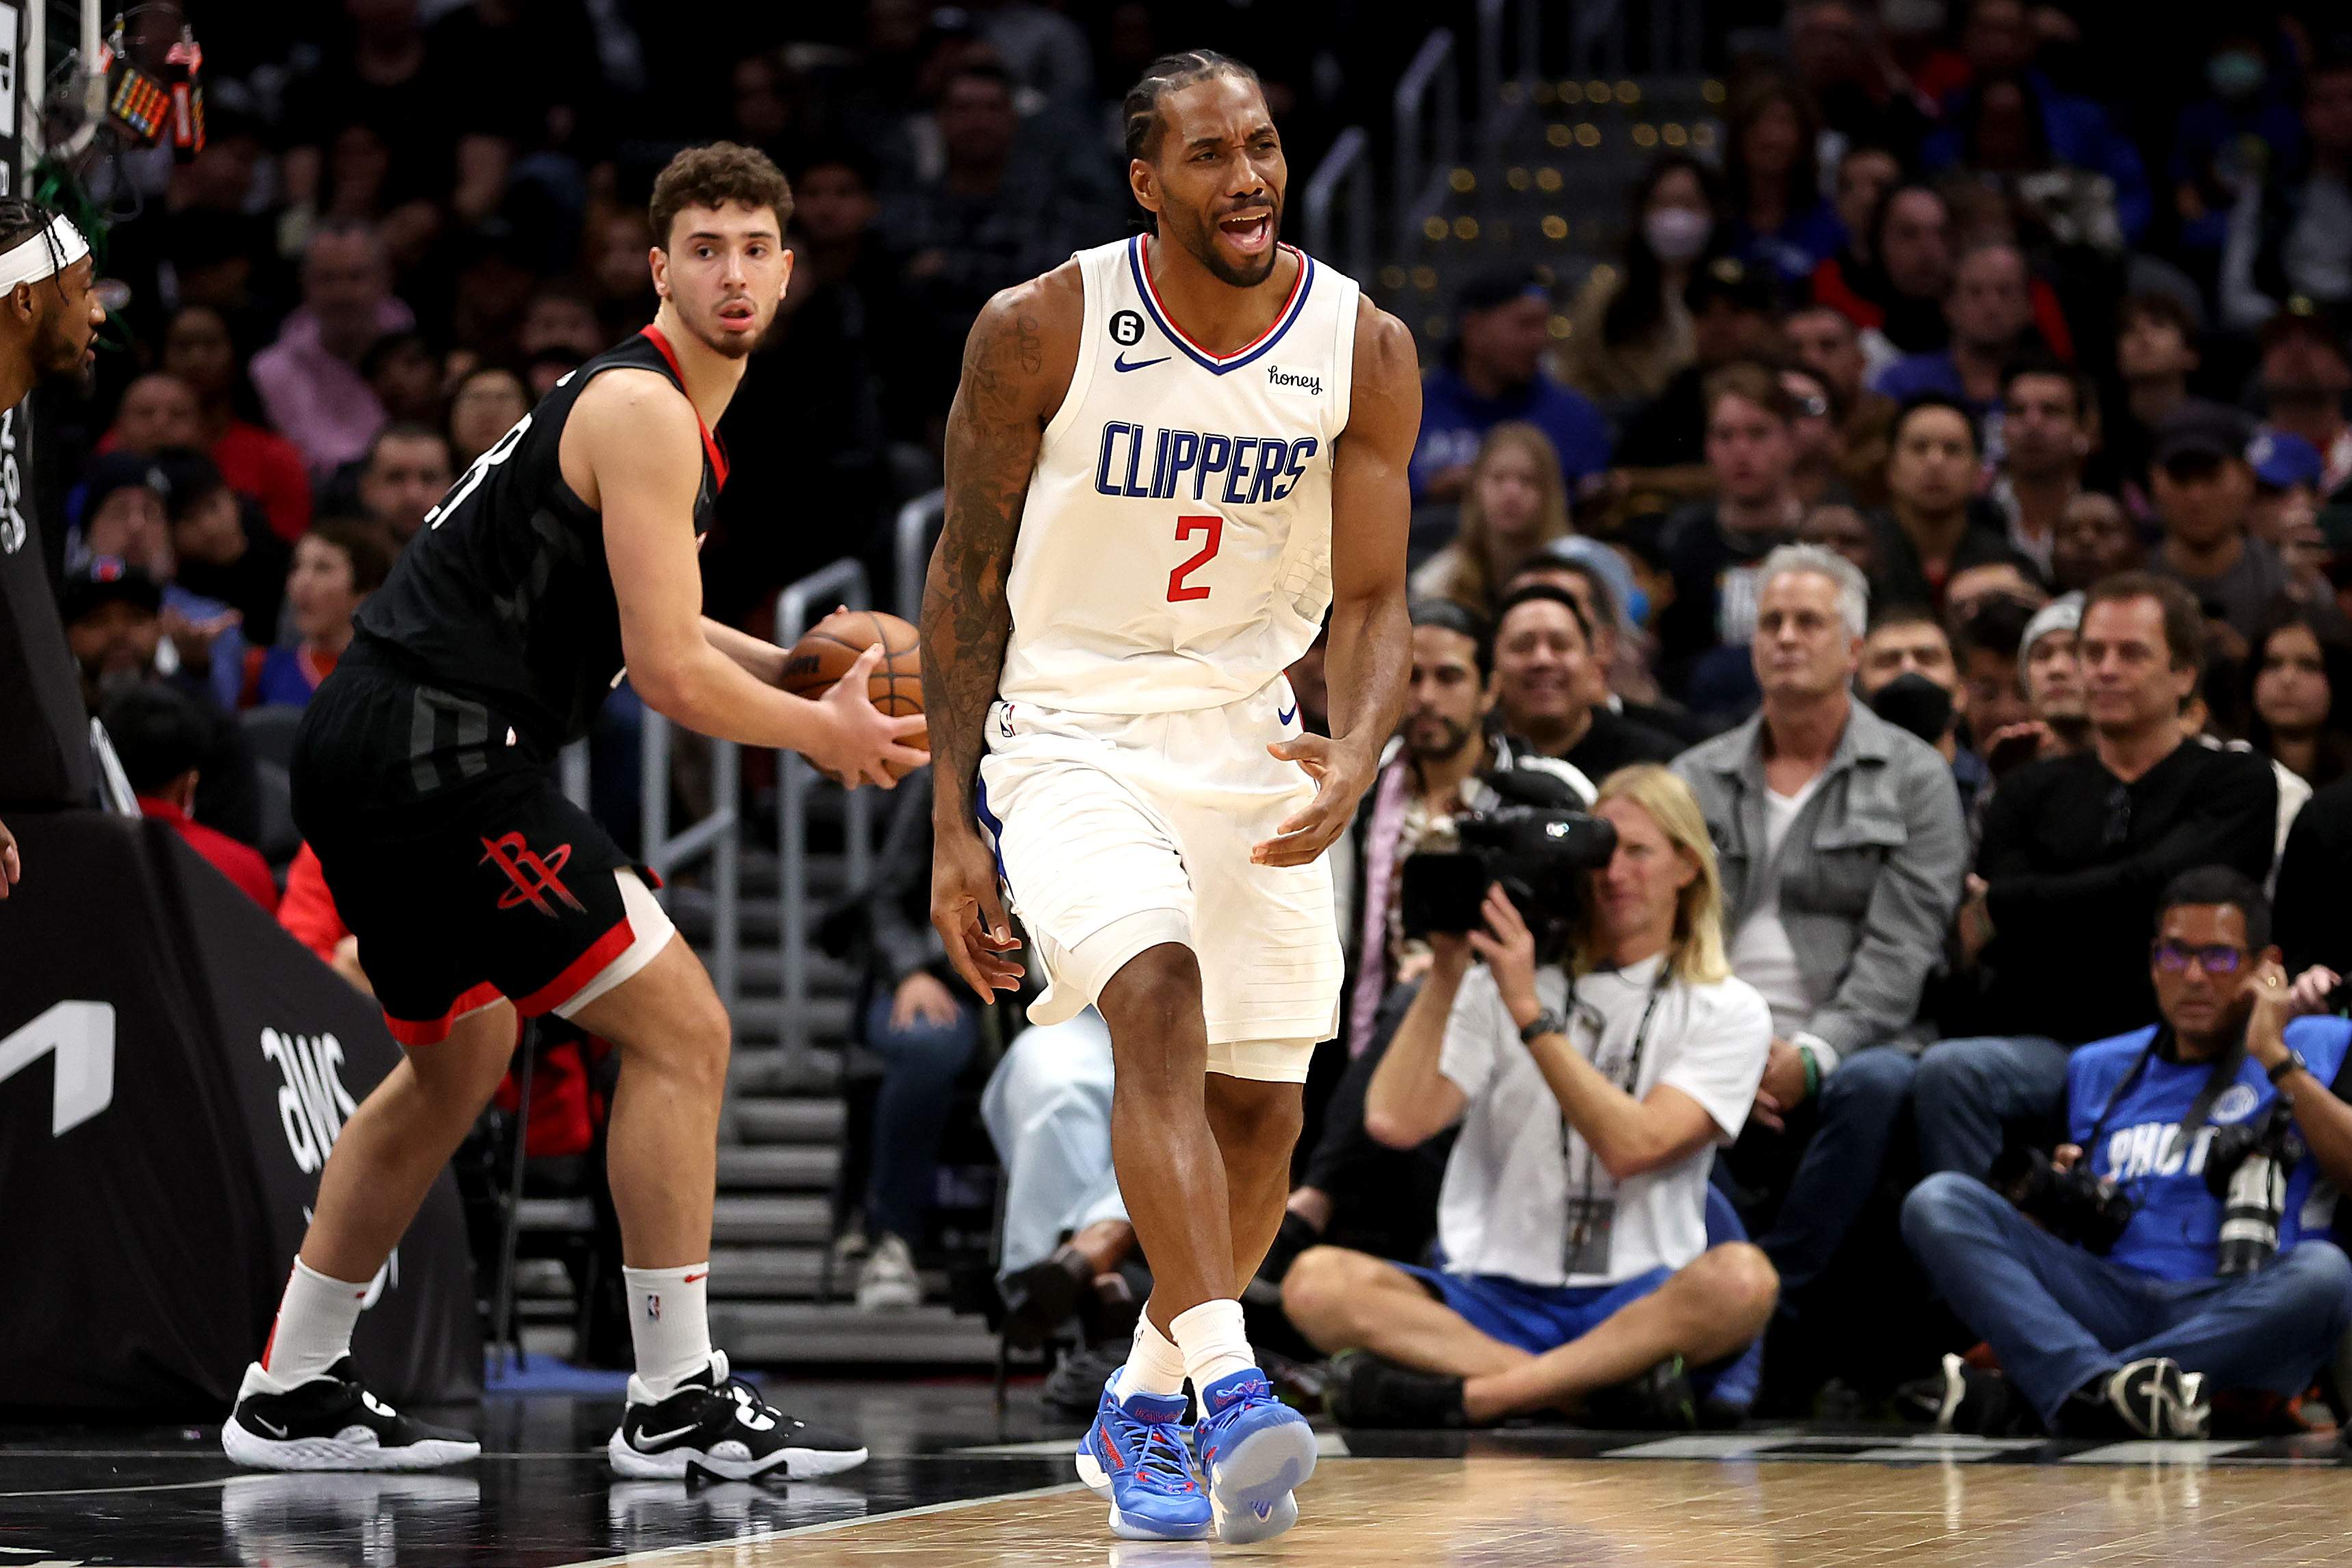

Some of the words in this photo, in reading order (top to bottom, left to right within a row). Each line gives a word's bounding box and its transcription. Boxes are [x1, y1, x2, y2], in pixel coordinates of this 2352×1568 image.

[1117, 315, 1137, 342] 6
[1268, 365, 1323, 395] honey
[1095, 421, 1318, 504] CLIPPERS
[1167, 516, 1223, 603] 2
